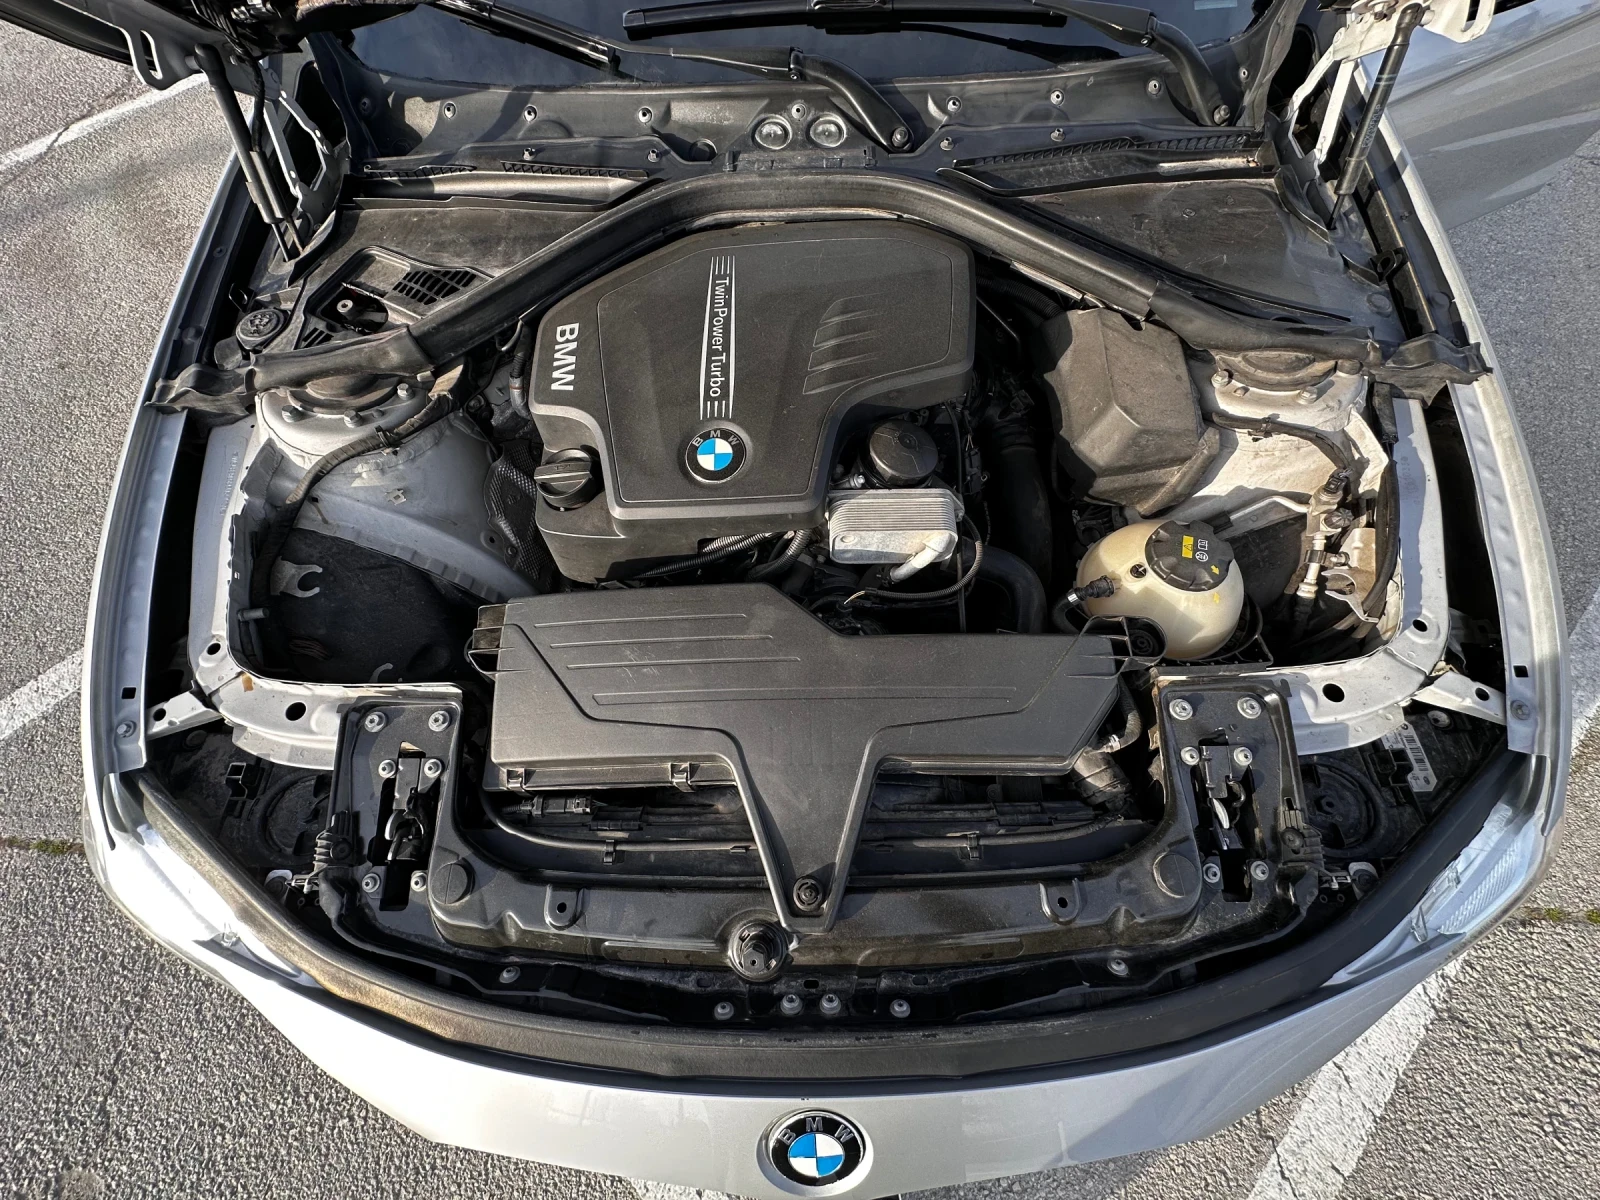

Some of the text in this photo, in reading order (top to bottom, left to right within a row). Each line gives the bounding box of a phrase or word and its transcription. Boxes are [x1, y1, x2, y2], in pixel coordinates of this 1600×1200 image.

[550, 322, 580, 391] BMW
[709, 276, 730, 398] TwinPower Turbo
[692, 430, 740, 447] BMW
[779, 1117, 854, 1146] BMW
